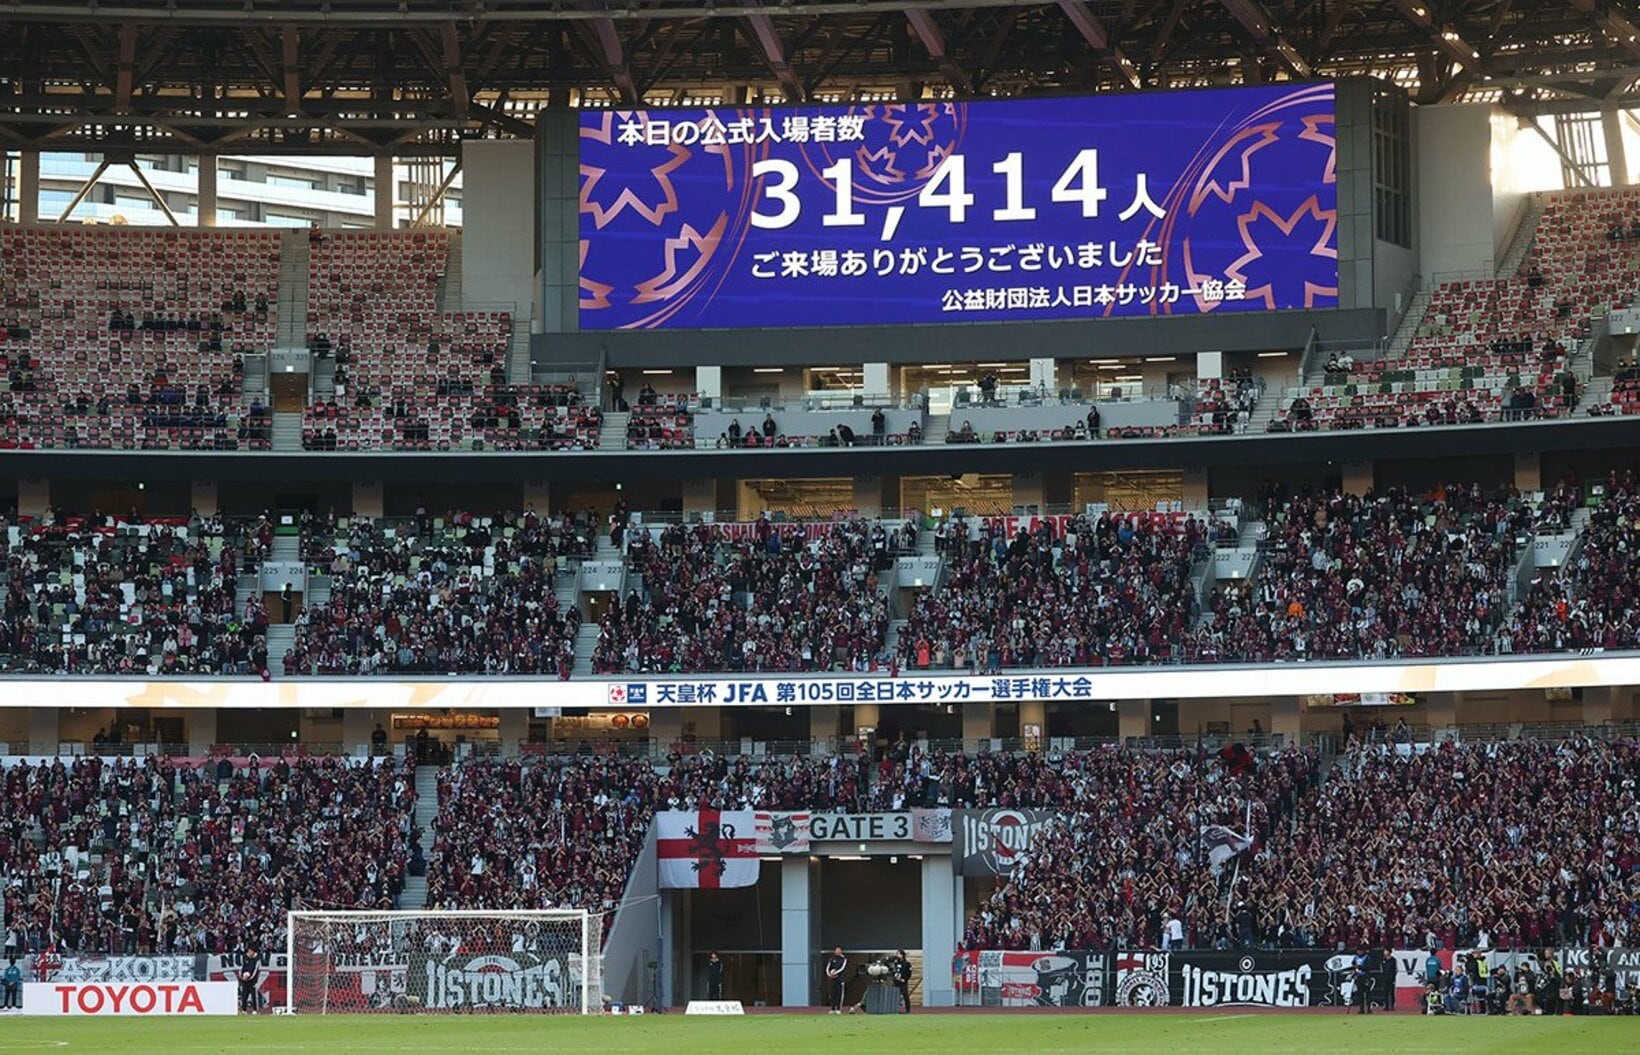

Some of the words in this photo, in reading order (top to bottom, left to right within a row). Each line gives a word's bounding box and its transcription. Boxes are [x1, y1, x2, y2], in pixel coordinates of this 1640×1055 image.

[617, 116, 865, 146] 本日の公式入場者数
[751, 239, 1163, 279] ご来場ありがとうございました
[941, 278, 1247, 312] 公益財団法人日本サッカー協会
[264, 566, 279, 574] 225
[656, 683, 717, 704] 天皇杯
[723, 683, 768, 703] JFA
[776, 677, 1092, 702] 第105回全日本サッカー選手権大会
[810, 816, 885, 839] GATE
[893, 816, 909, 838] 3
[55, 985, 205, 1014] TOYOTA
